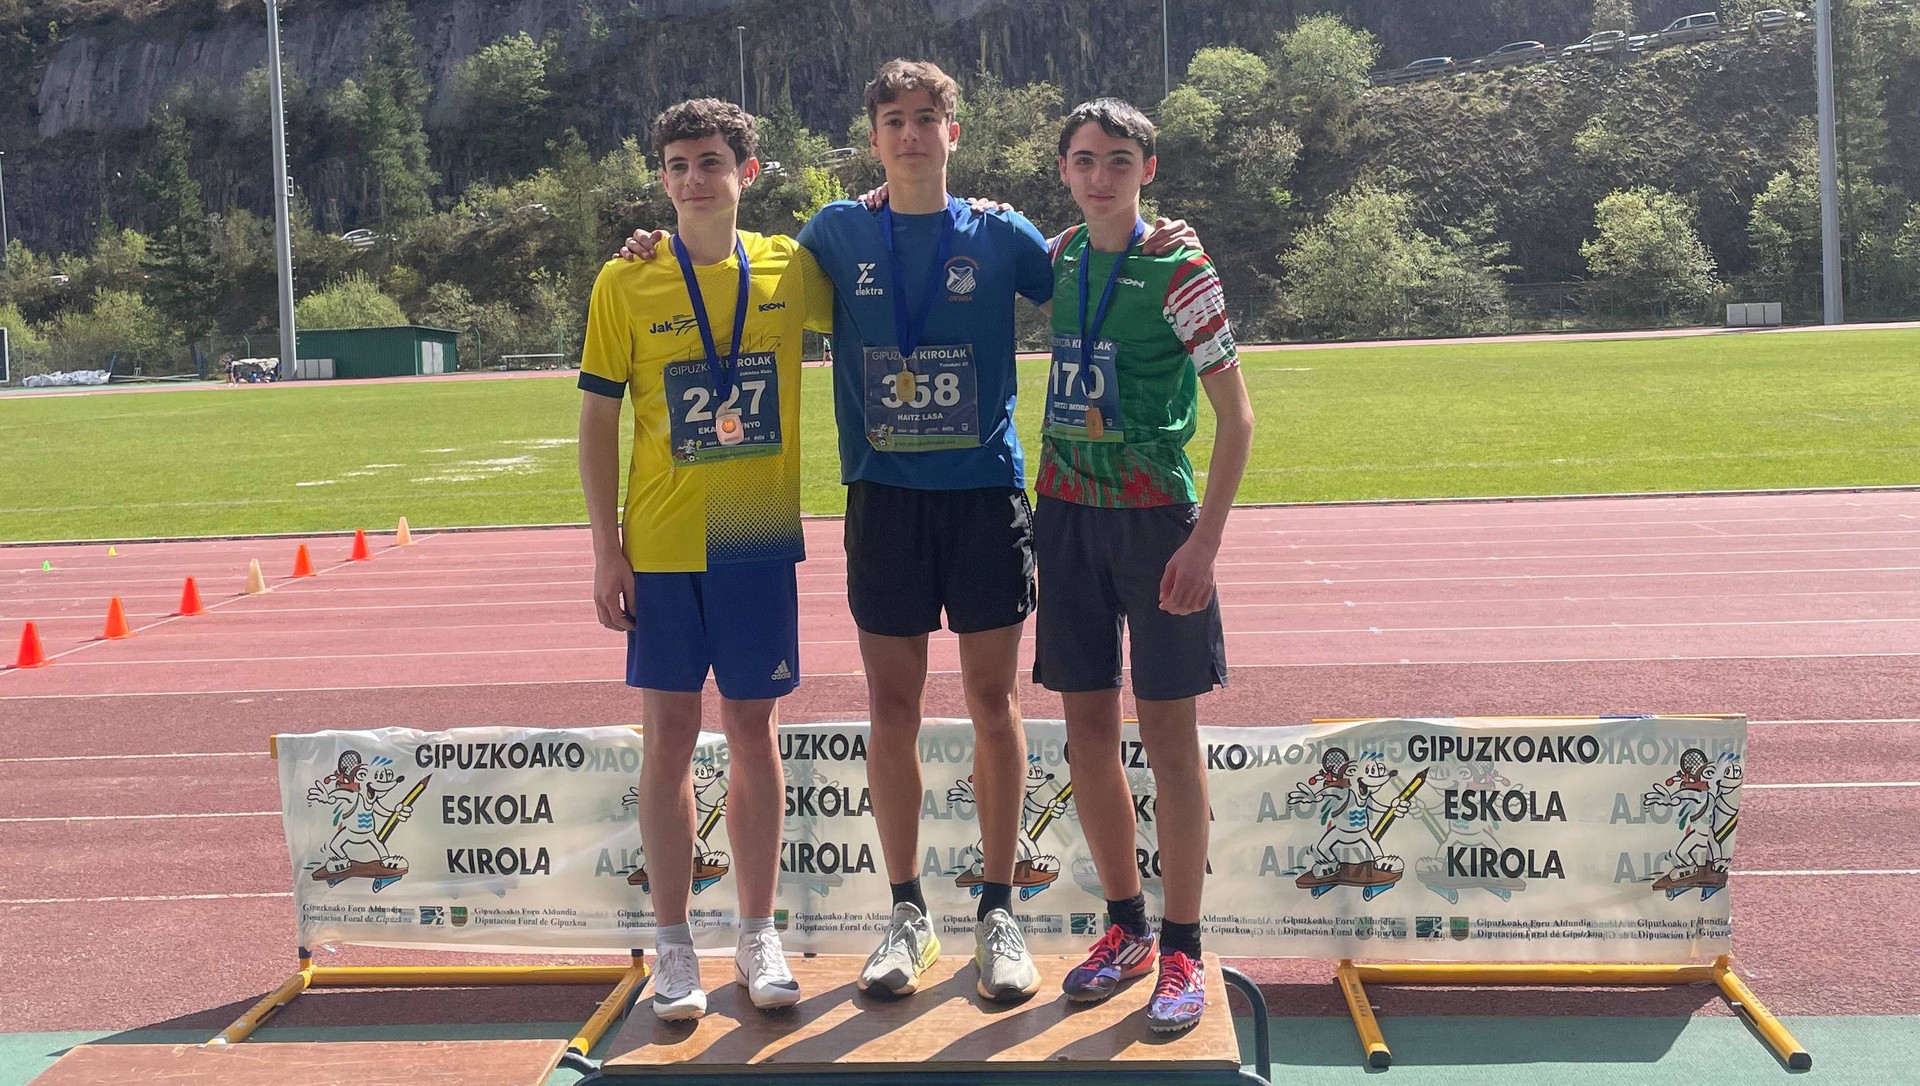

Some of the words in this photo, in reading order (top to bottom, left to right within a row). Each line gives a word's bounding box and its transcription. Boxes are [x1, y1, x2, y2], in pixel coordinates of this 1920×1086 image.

[855, 284, 883, 296] elektra
[649, 321, 673, 334] Jak
[1072, 339, 1112, 351] KILAK
[920, 349, 967, 360] KIROLAK
[1052, 361, 1105, 399] 170
[881, 372, 960, 409] 358
[682, 380, 766, 423] 227
[897, 413, 920, 421] HAITZ
[922, 412, 943, 421] LASA
[771, 672, 791, 681] adidas
[1408, 735, 1600, 763] GIPUZKOAKO
[415, 742, 585, 770] GIPUZKOAKO
[785, 785, 875, 818] SKOLA
[1444, 789, 1567, 822] ESKOLA
[442, 794, 554, 825] ESKOLA
[447, 847, 550, 876] KIROLA
[1447, 846, 1566, 879] KIROLA
[302, 904, 346, 914] Gipuzkoako
[347, 904, 366, 913] Foru
[474, 907, 520, 916] Gipuzkoako
[521, 908, 540, 916] Foru
[541, 908, 577, 916] Aldundia
[343, 915, 363, 923] Foral
[364, 915, 373, 923] de
[376, 915, 412, 925] Gipuzkoa
[474, 917, 517, 928] Diputación
[518, 918, 538, 926] Foral
[538, 918, 548, 926] de
[550, 918, 587, 928] Gipuzkoa
[795, 912, 842, 922] Gipuzkoako
[844, 912, 863, 921] Foru
[943, 915, 977, 925] Gipuzko
[1201, 915, 1239, 923] Aldundia
[1283, 916, 1333, 926] Gipuzkoako
[1335, 917, 1355, 926] Foru
[1358, 917, 1396, 926] Aldundia
[694, 919, 731, 929] Gipuzkoa
[795, 922, 838, 932] Diputación
[840, 923, 860, 931] Foral
[862, 923, 872, 931] de
[1476, 918, 1528, 928] Gipuzkoako
[1530, 919, 1550, 928] Foru
[1553, 919, 1591, 928] Aldundia
[1637, 918, 1688, 929] Gipuzkoako
[943, 925, 976, 934] Diputac
[1023, 925, 1062, 935] Gipuzkoa
[1211, 926, 1251, 935] Gipuzkoa
[1283, 926, 1328, 937] Diputación
[1331, 927, 1353, 937] Foral
[1355, 928, 1365, 936] de
[1367, 927, 1407, 937] Gipuzkoa
[1477, 929, 1523, 939] Diputación
[1550, 930, 1560, 938] de
[1562, 930, 1603, 940] Gipuzkoa
[1638, 930, 1684, 940] Diputación
